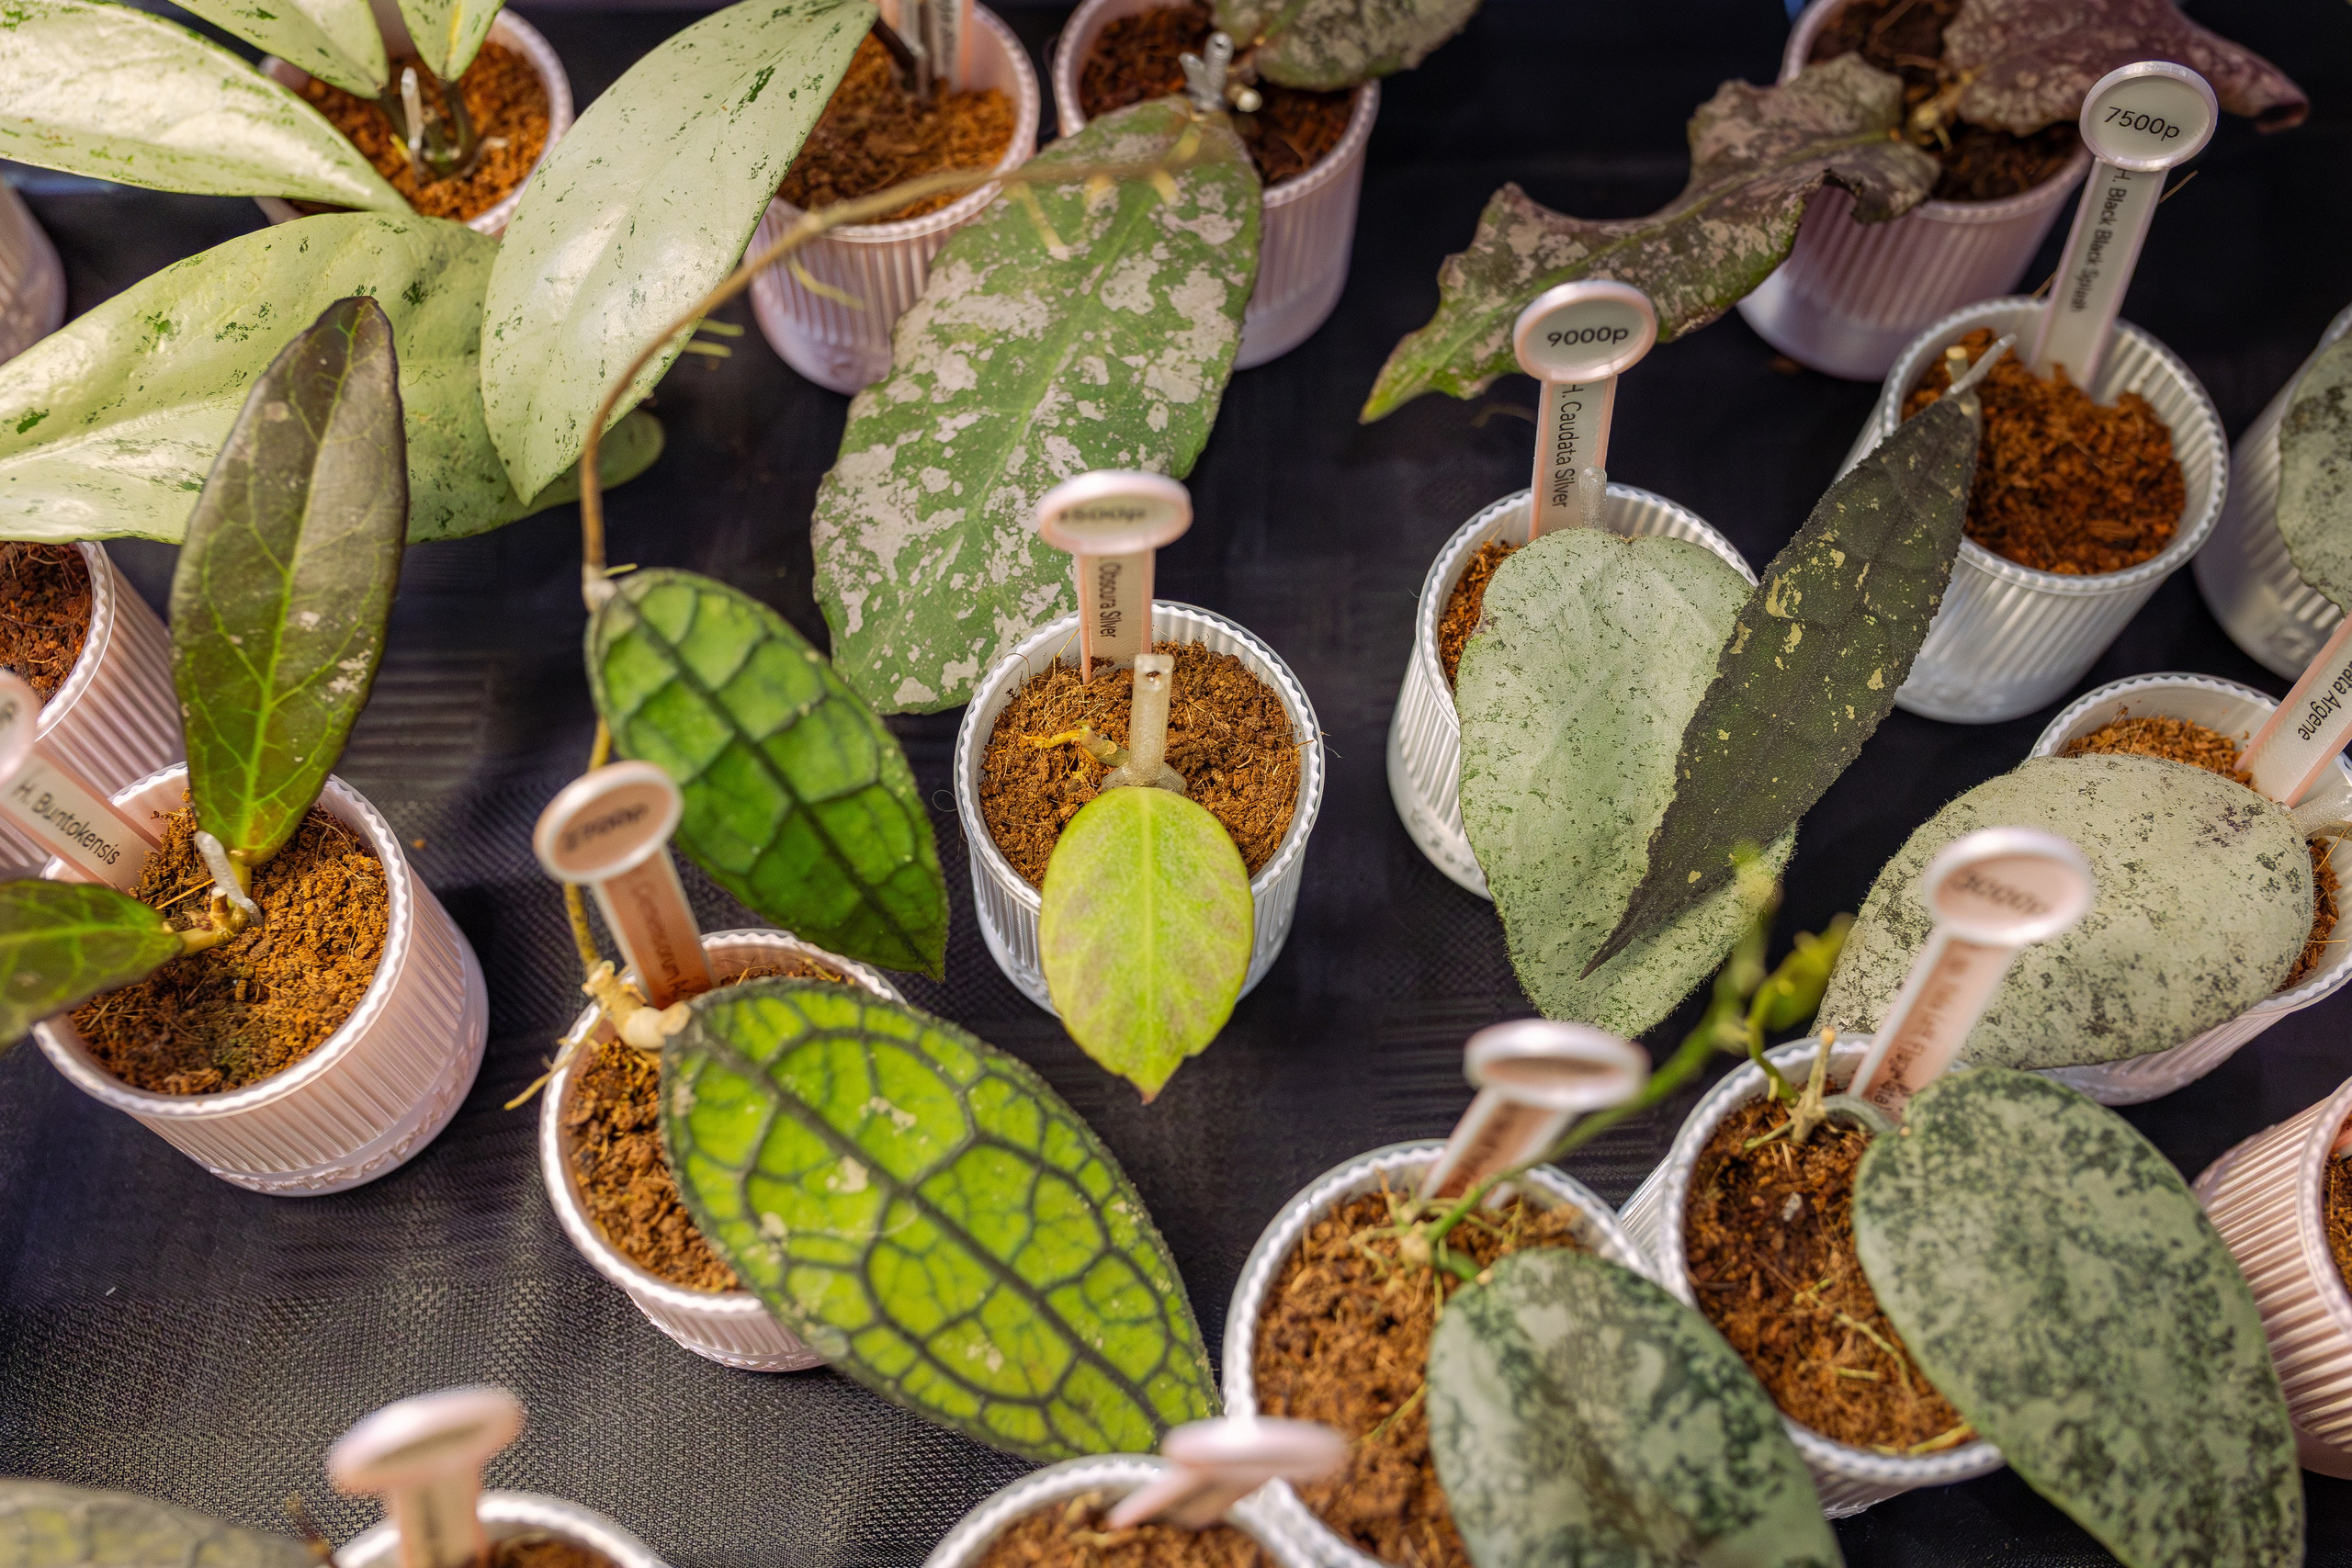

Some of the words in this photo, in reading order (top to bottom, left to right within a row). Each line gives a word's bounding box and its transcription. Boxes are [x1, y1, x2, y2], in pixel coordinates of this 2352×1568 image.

[2104, 106, 2180, 141] 7500p
[2100, 186, 2127, 226] Black
[2086, 229, 2112, 265] Black
[1546, 326, 1629, 347] 9000p
[1555, 400, 1582, 466] Caudata
[1553, 468, 1576, 508] Silver
[1100, 609, 1122, 638] Silver
[2297, 690, 2342, 741] Argene
[31, 792, 120, 865] Buntokensis
